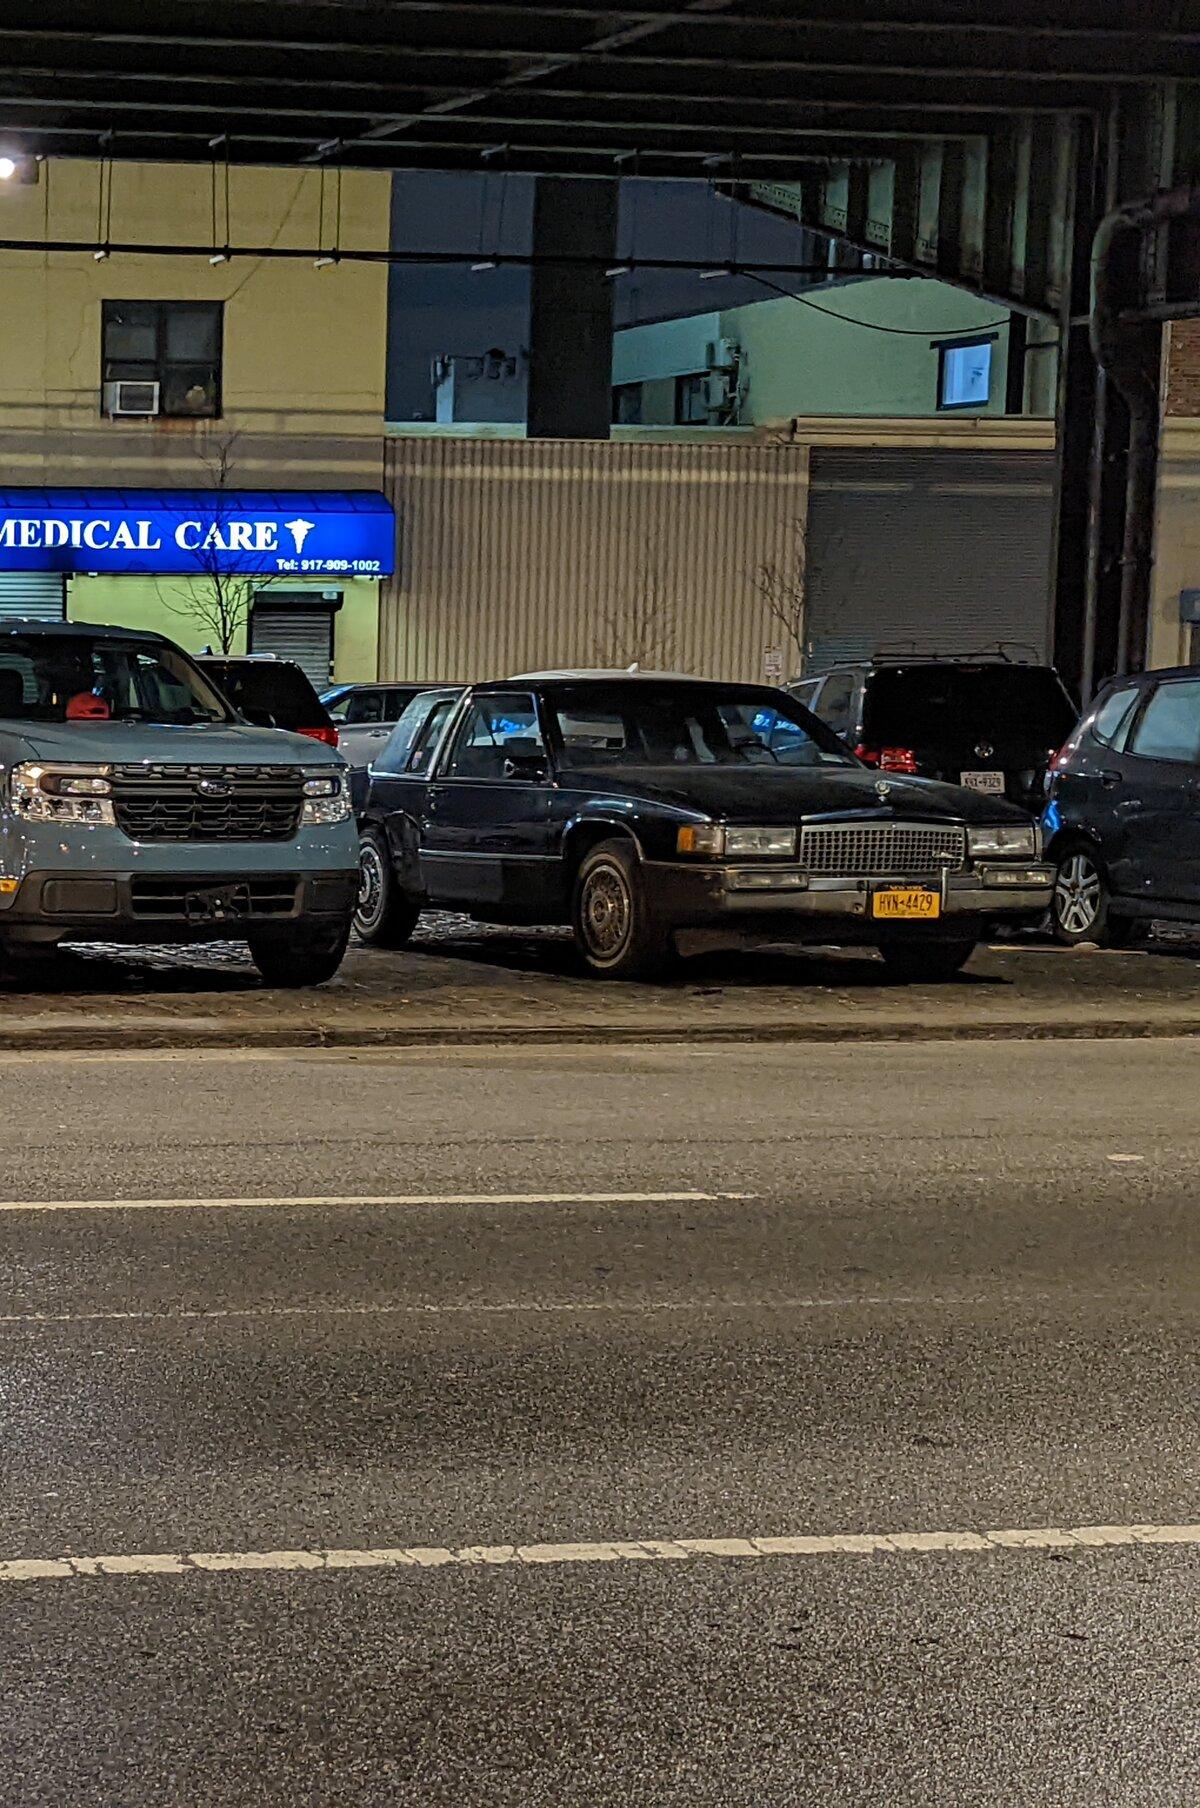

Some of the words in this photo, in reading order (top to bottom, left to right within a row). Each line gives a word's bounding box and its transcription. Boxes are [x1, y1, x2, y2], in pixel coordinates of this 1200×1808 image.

[174, 521, 279, 551] CARE
[276, 558, 299, 571] Tel:
[301, 559, 380, 571] 917-909-1002
